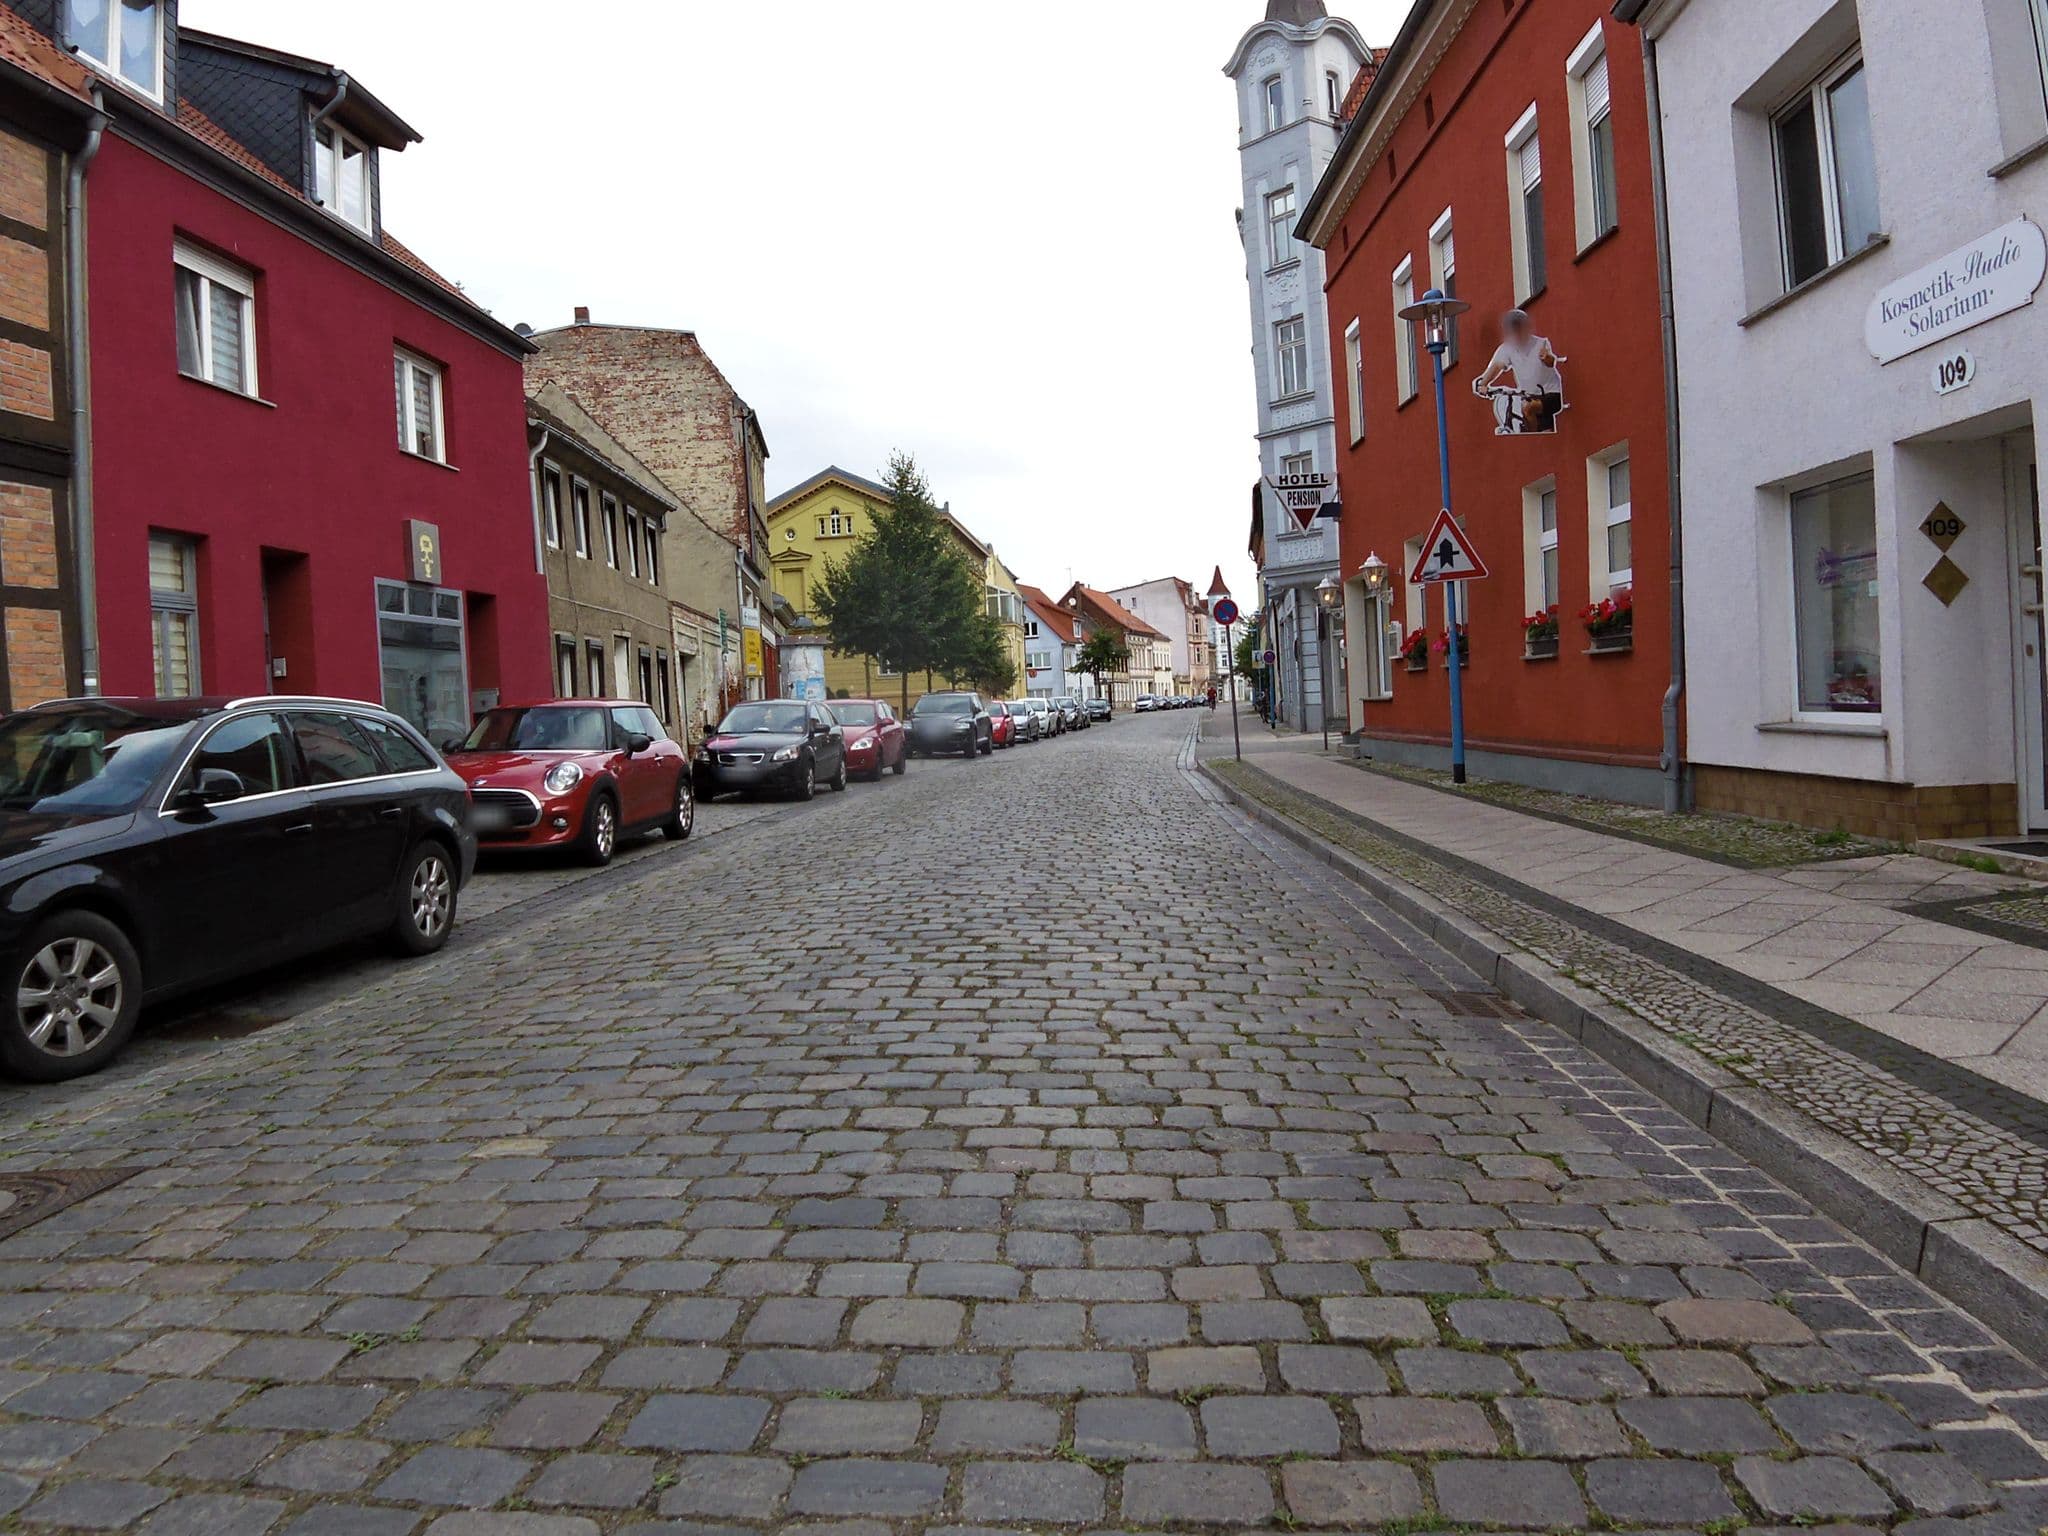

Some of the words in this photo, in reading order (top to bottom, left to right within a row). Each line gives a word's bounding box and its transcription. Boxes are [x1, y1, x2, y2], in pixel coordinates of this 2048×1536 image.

[1938, 355, 1967, 388] 109
[1279, 473, 1328, 485] HOTEL
[1287, 490, 1321, 506] PENSION
[1925, 519, 1959, 536] 109
